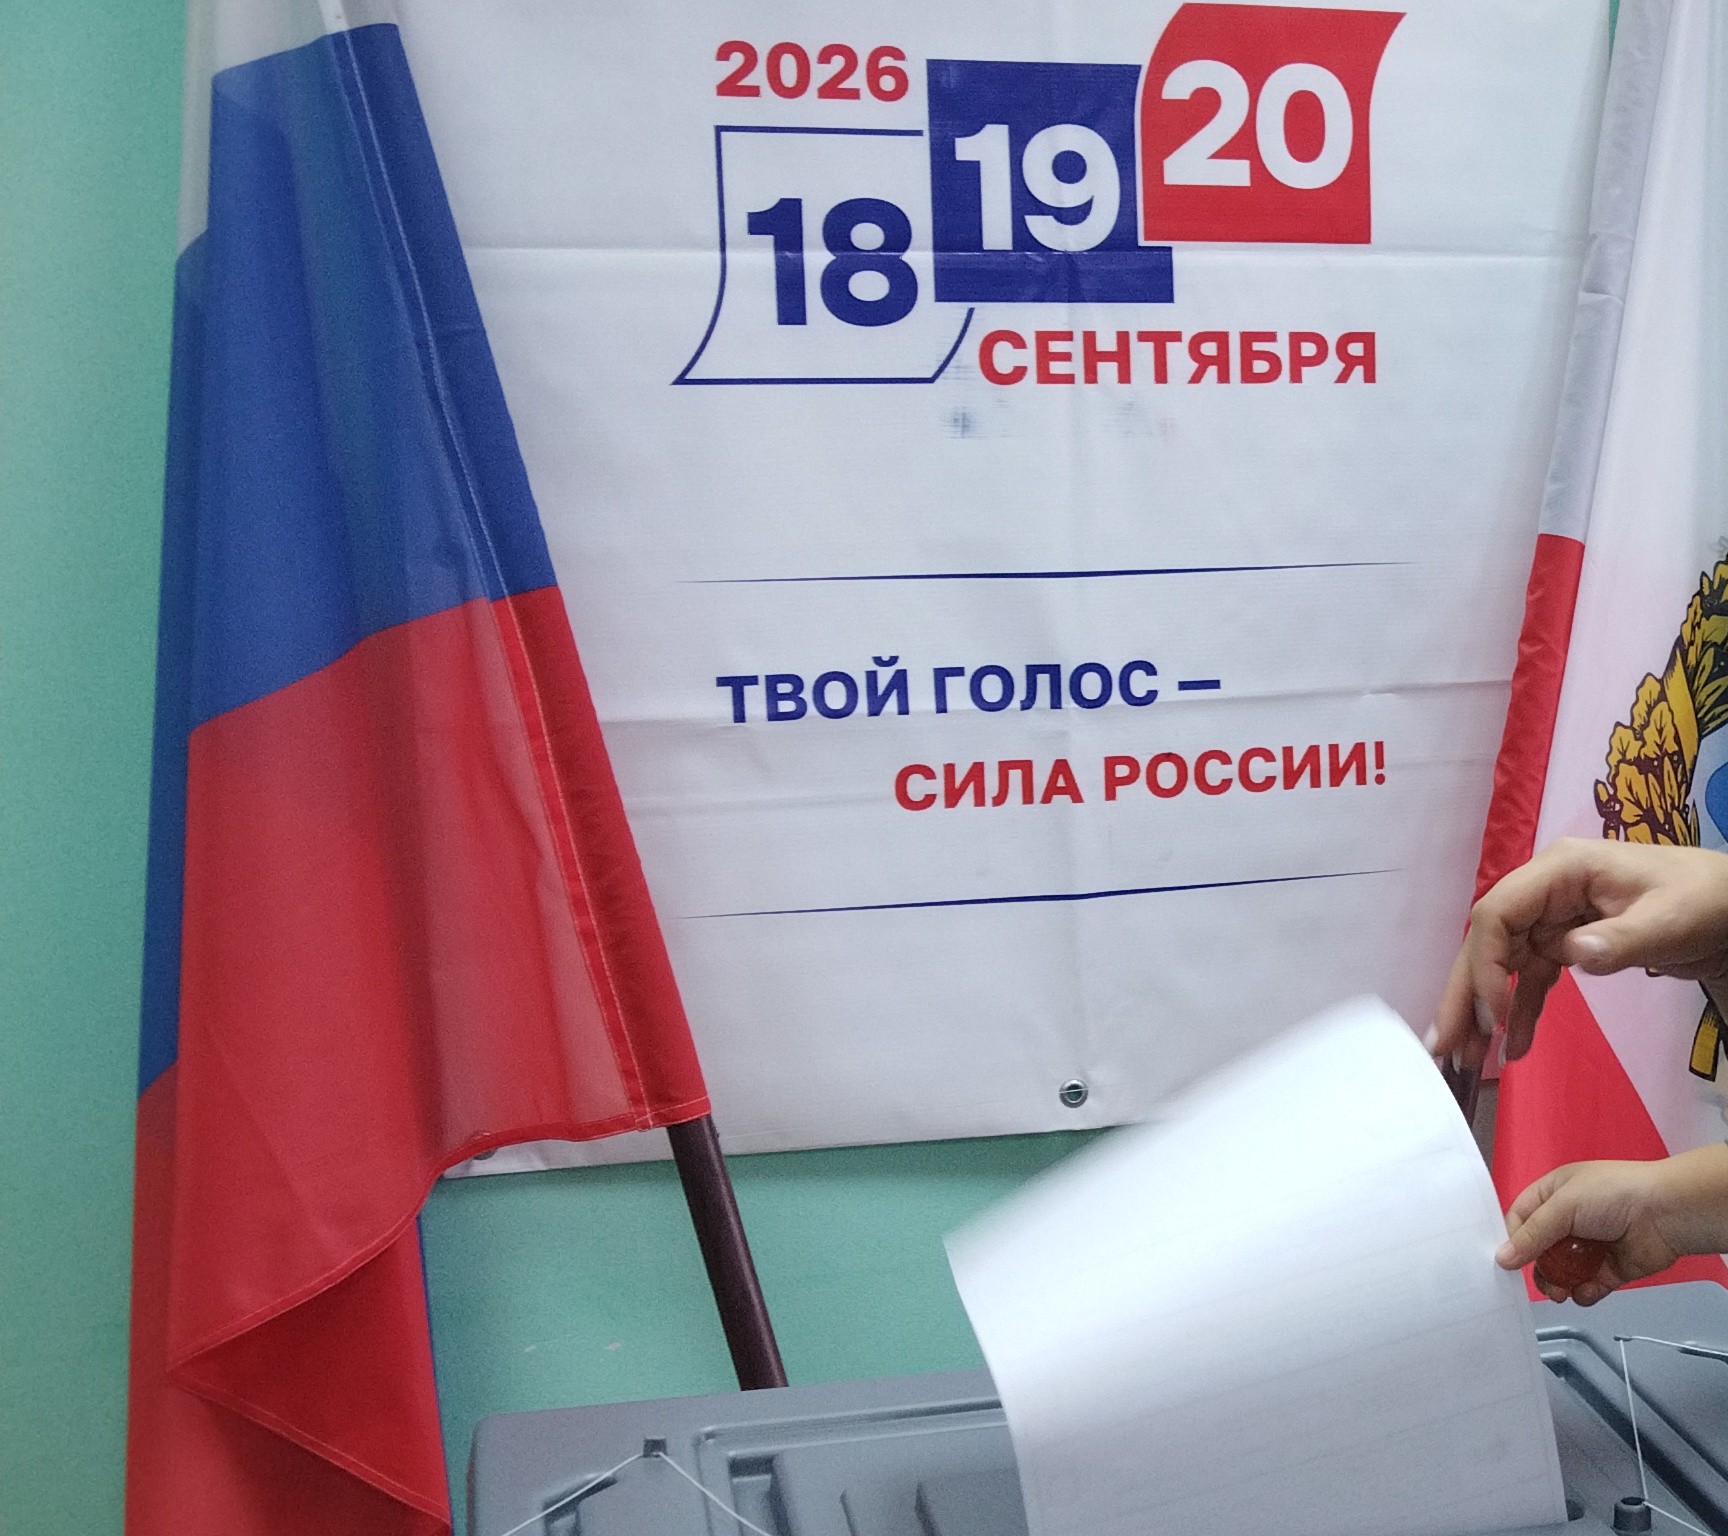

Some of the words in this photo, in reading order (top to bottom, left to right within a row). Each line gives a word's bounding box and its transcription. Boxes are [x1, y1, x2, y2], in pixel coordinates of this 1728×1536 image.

[715, 39, 909, 103] 2026
[746, 197, 919, 328] 18
[955, 123, 1120, 252] 19
[1161, 59, 1353, 190] 20
[978, 329, 1377, 386] СЕНТЯБРЯ
[715, 655, 911, 724] ТВОЙ
[932, 659, 1159, 715] ГОЛОС
[894, 758, 1084, 812] СИЛА
[1103, 740, 1386, 801] РОССИИ!
